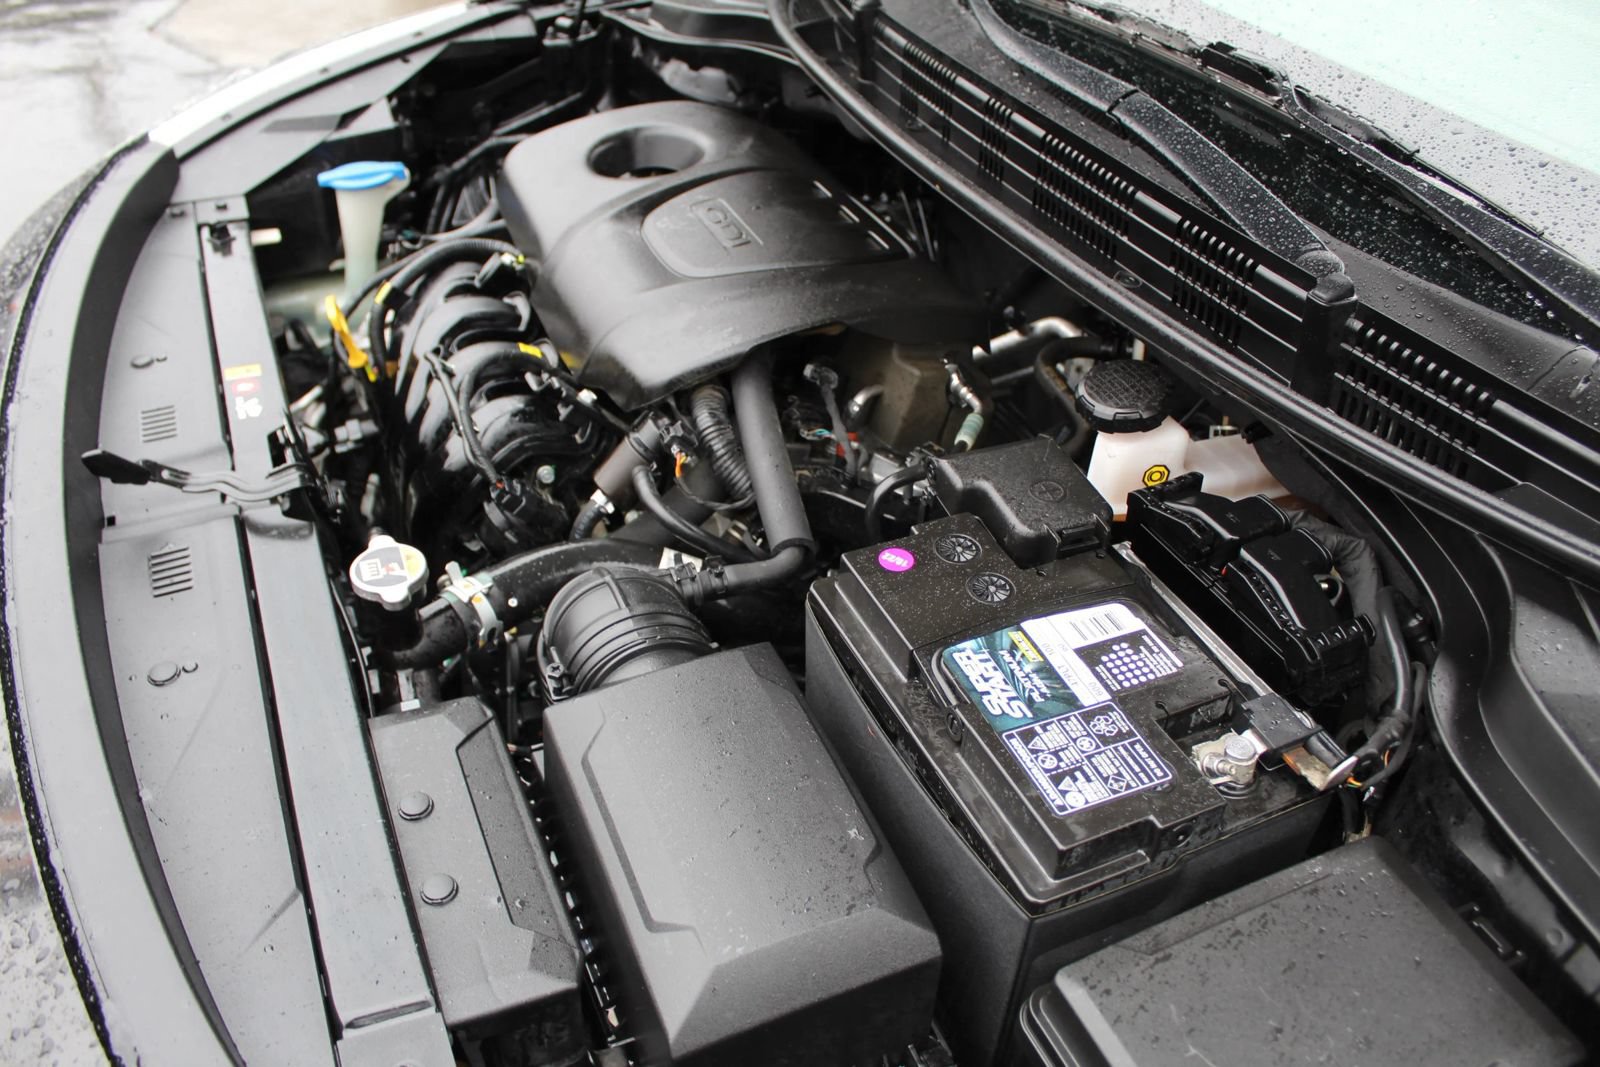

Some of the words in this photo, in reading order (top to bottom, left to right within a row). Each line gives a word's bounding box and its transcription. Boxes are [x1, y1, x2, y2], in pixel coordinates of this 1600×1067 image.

[952, 651, 1003, 715] SUPER
[966, 650, 1034, 717] START
[998, 650, 1045, 701] PLATINUM
